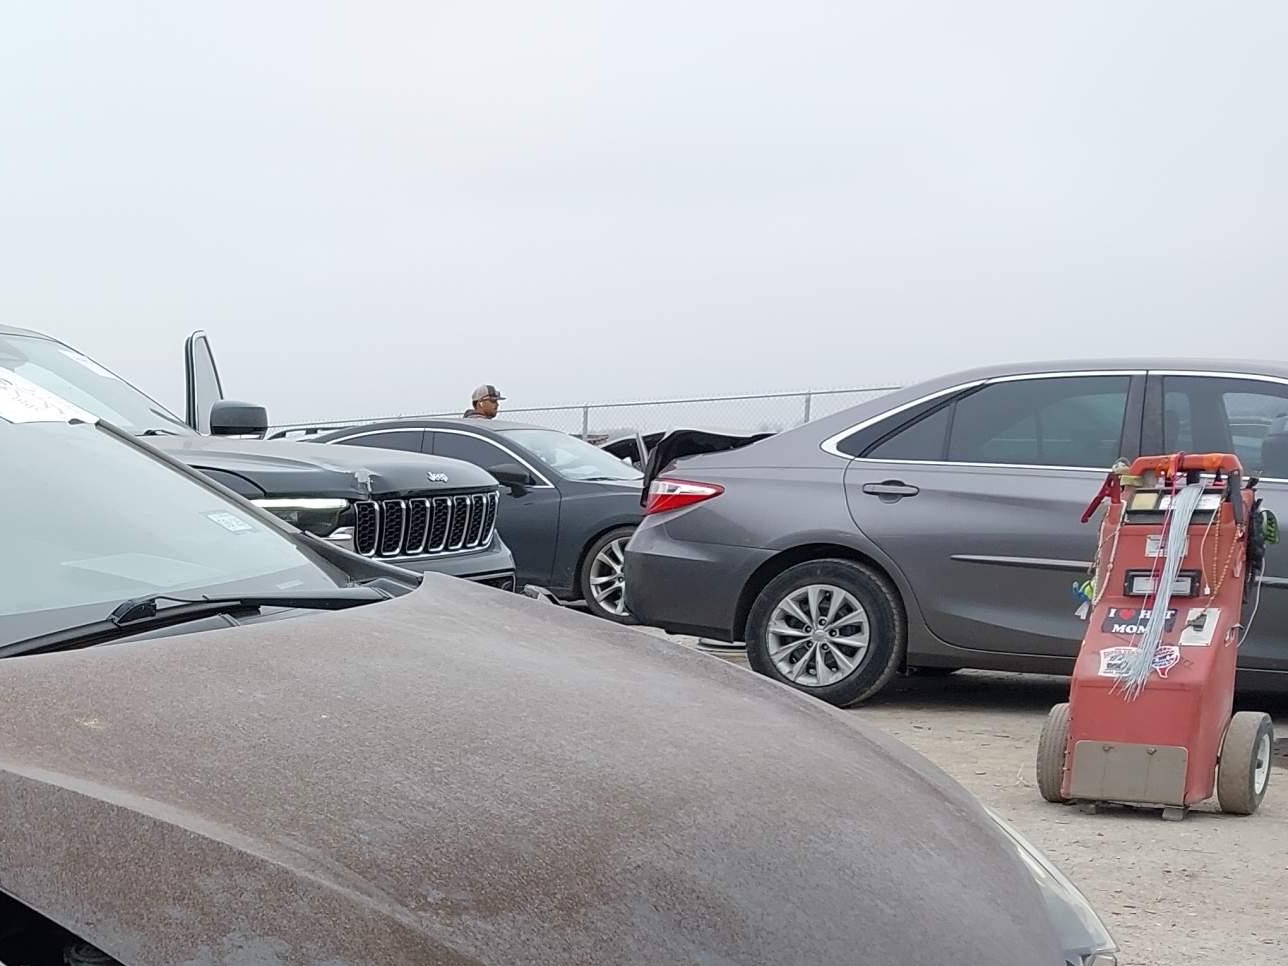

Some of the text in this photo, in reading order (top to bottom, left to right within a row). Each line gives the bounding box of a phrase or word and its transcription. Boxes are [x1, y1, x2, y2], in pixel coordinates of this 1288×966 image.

[426, 471, 449, 483] Jeep
[1108, 608, 1176, 620] I HT
